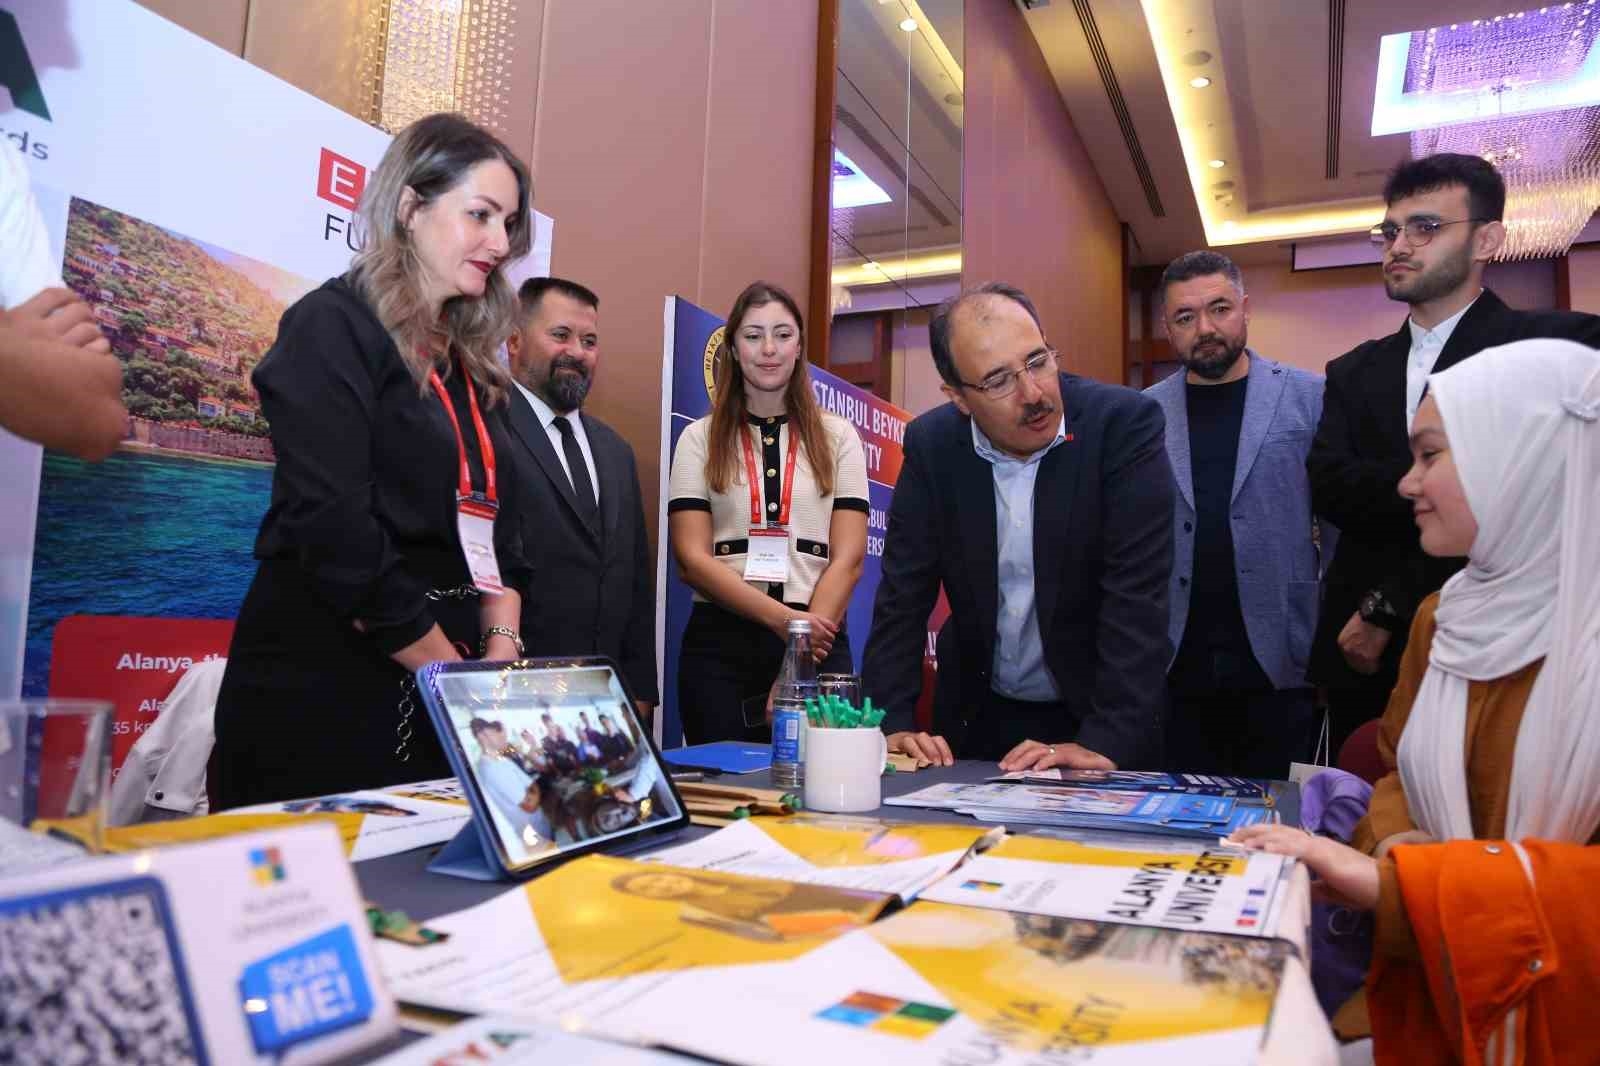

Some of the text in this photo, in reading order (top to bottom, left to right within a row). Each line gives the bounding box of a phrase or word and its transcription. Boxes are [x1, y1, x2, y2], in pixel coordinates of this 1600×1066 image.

[812, 380, 870, 431] STANBUL
[1106, 861, 1181, 920] ALANYA
[1161, 848, 1233, 924] UNIVERSIT
[270, 972, 357, 1036] ME!
